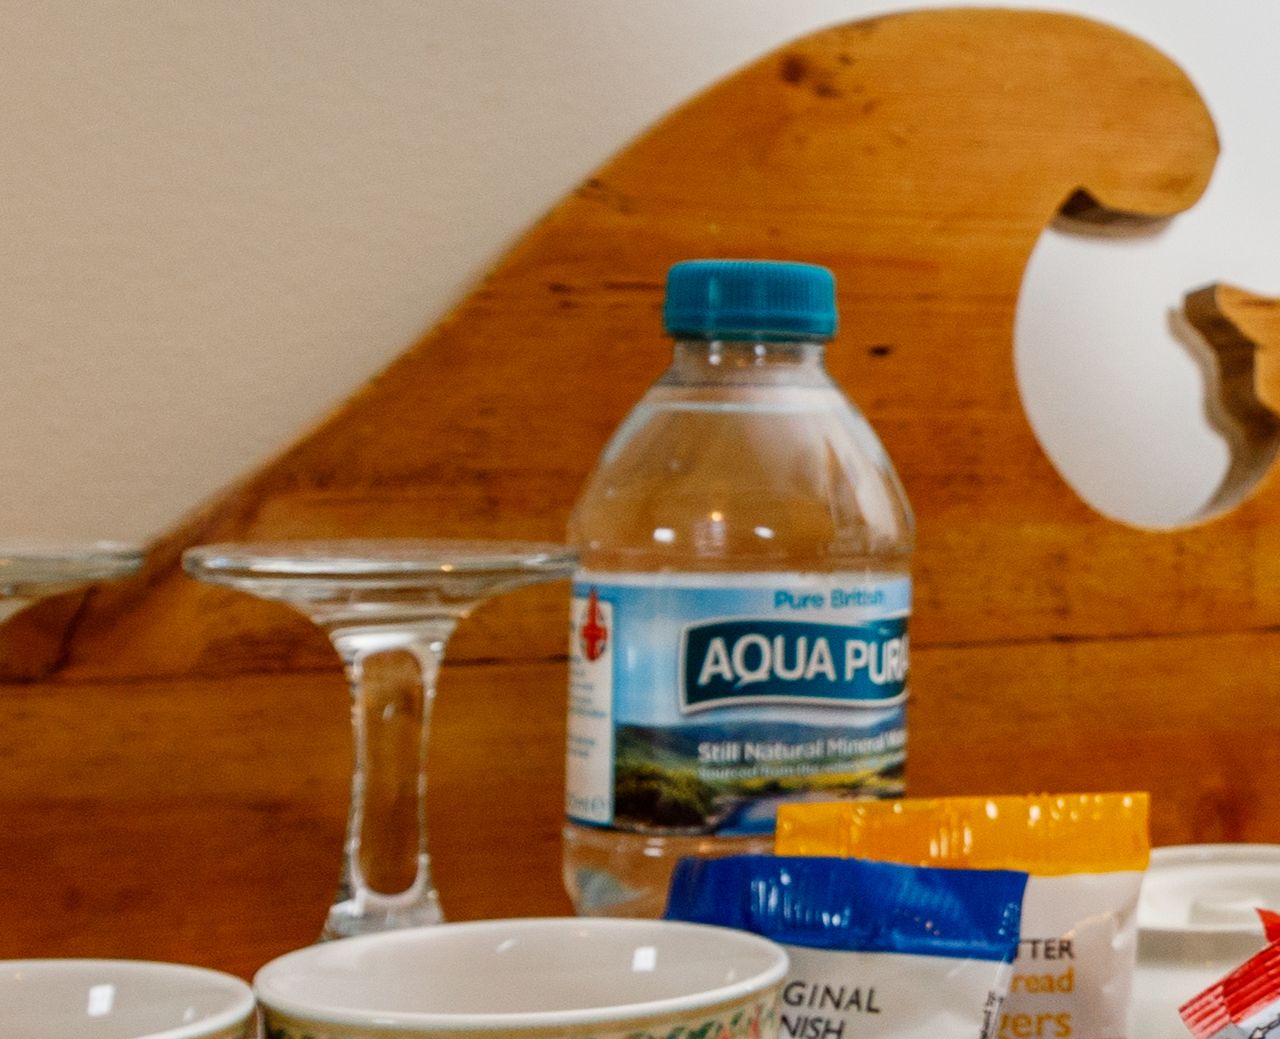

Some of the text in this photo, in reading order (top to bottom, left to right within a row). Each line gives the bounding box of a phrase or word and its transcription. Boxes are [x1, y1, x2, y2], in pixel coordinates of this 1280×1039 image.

[774, 588, 884, 609] Pure British
[697, 634, 837, 687] AQUA
[698, 741, 741, 763] Still
[744, 739, 823, 761] Natural
[827, 732, 884, 755] Mineral
[782, 980, 881, 1014] GINAL
